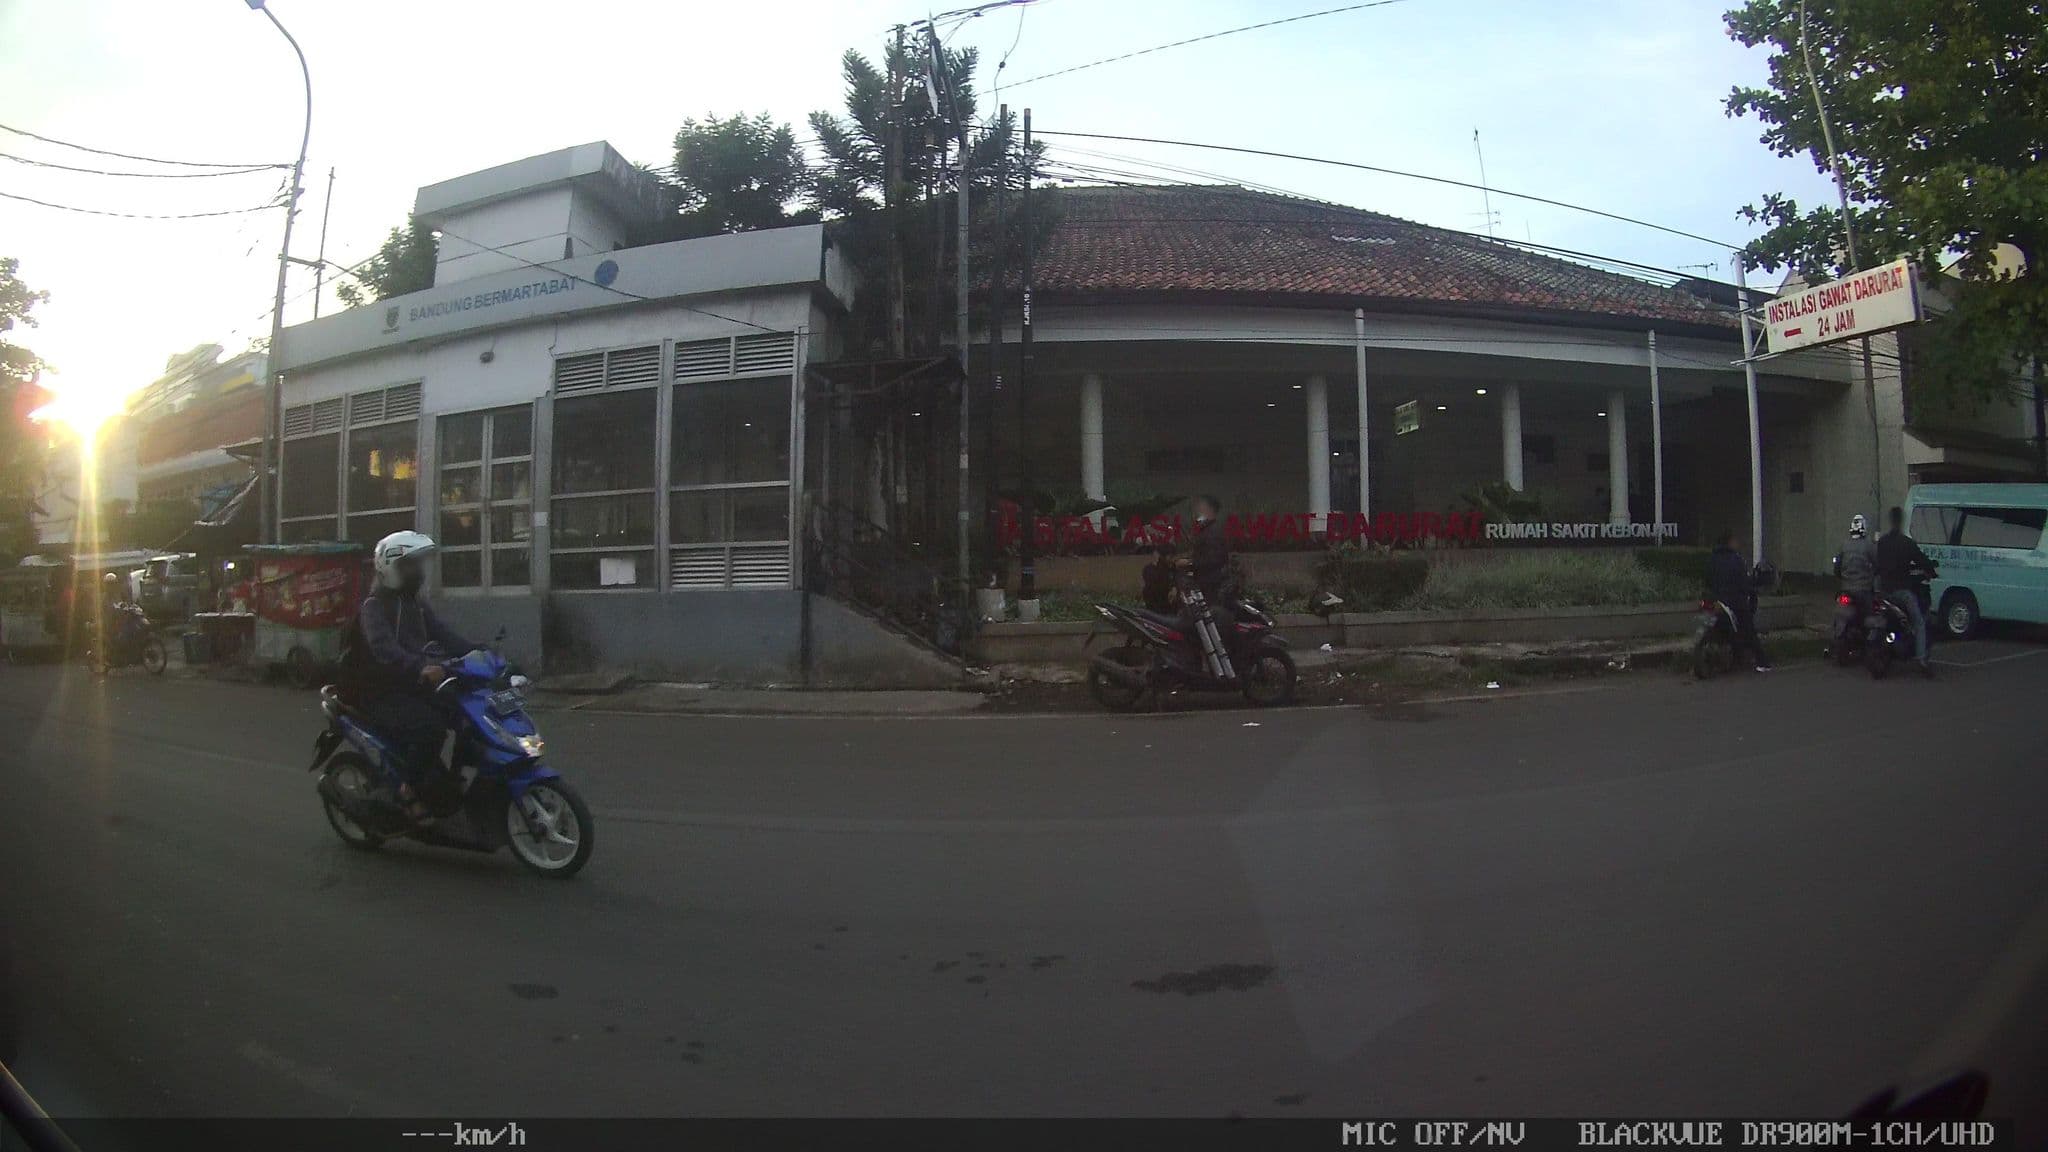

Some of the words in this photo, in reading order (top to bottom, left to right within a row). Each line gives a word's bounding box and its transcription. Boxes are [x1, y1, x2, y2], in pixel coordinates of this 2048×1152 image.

[409, 297, 472, 322] BANDUNG
[473, 276, 578, 309] BERMARTABAT
[1768, 294, 1817, 325] INSTALASI
[1819, 281, 1852, 310] GAWAT
[1854, 266, 1904, 300] DARURAT
[1817, 317, 1831, 337] 24
[1834, 309, 1856, 333] JAM
[1327, 511, 1486, 542] DARURAT
[1485, 522, 1548, 540] RUMAH
[1551, 522, 1599, 539] SAKIT
[1600, 522, 1679, 539] KEBONJATI
